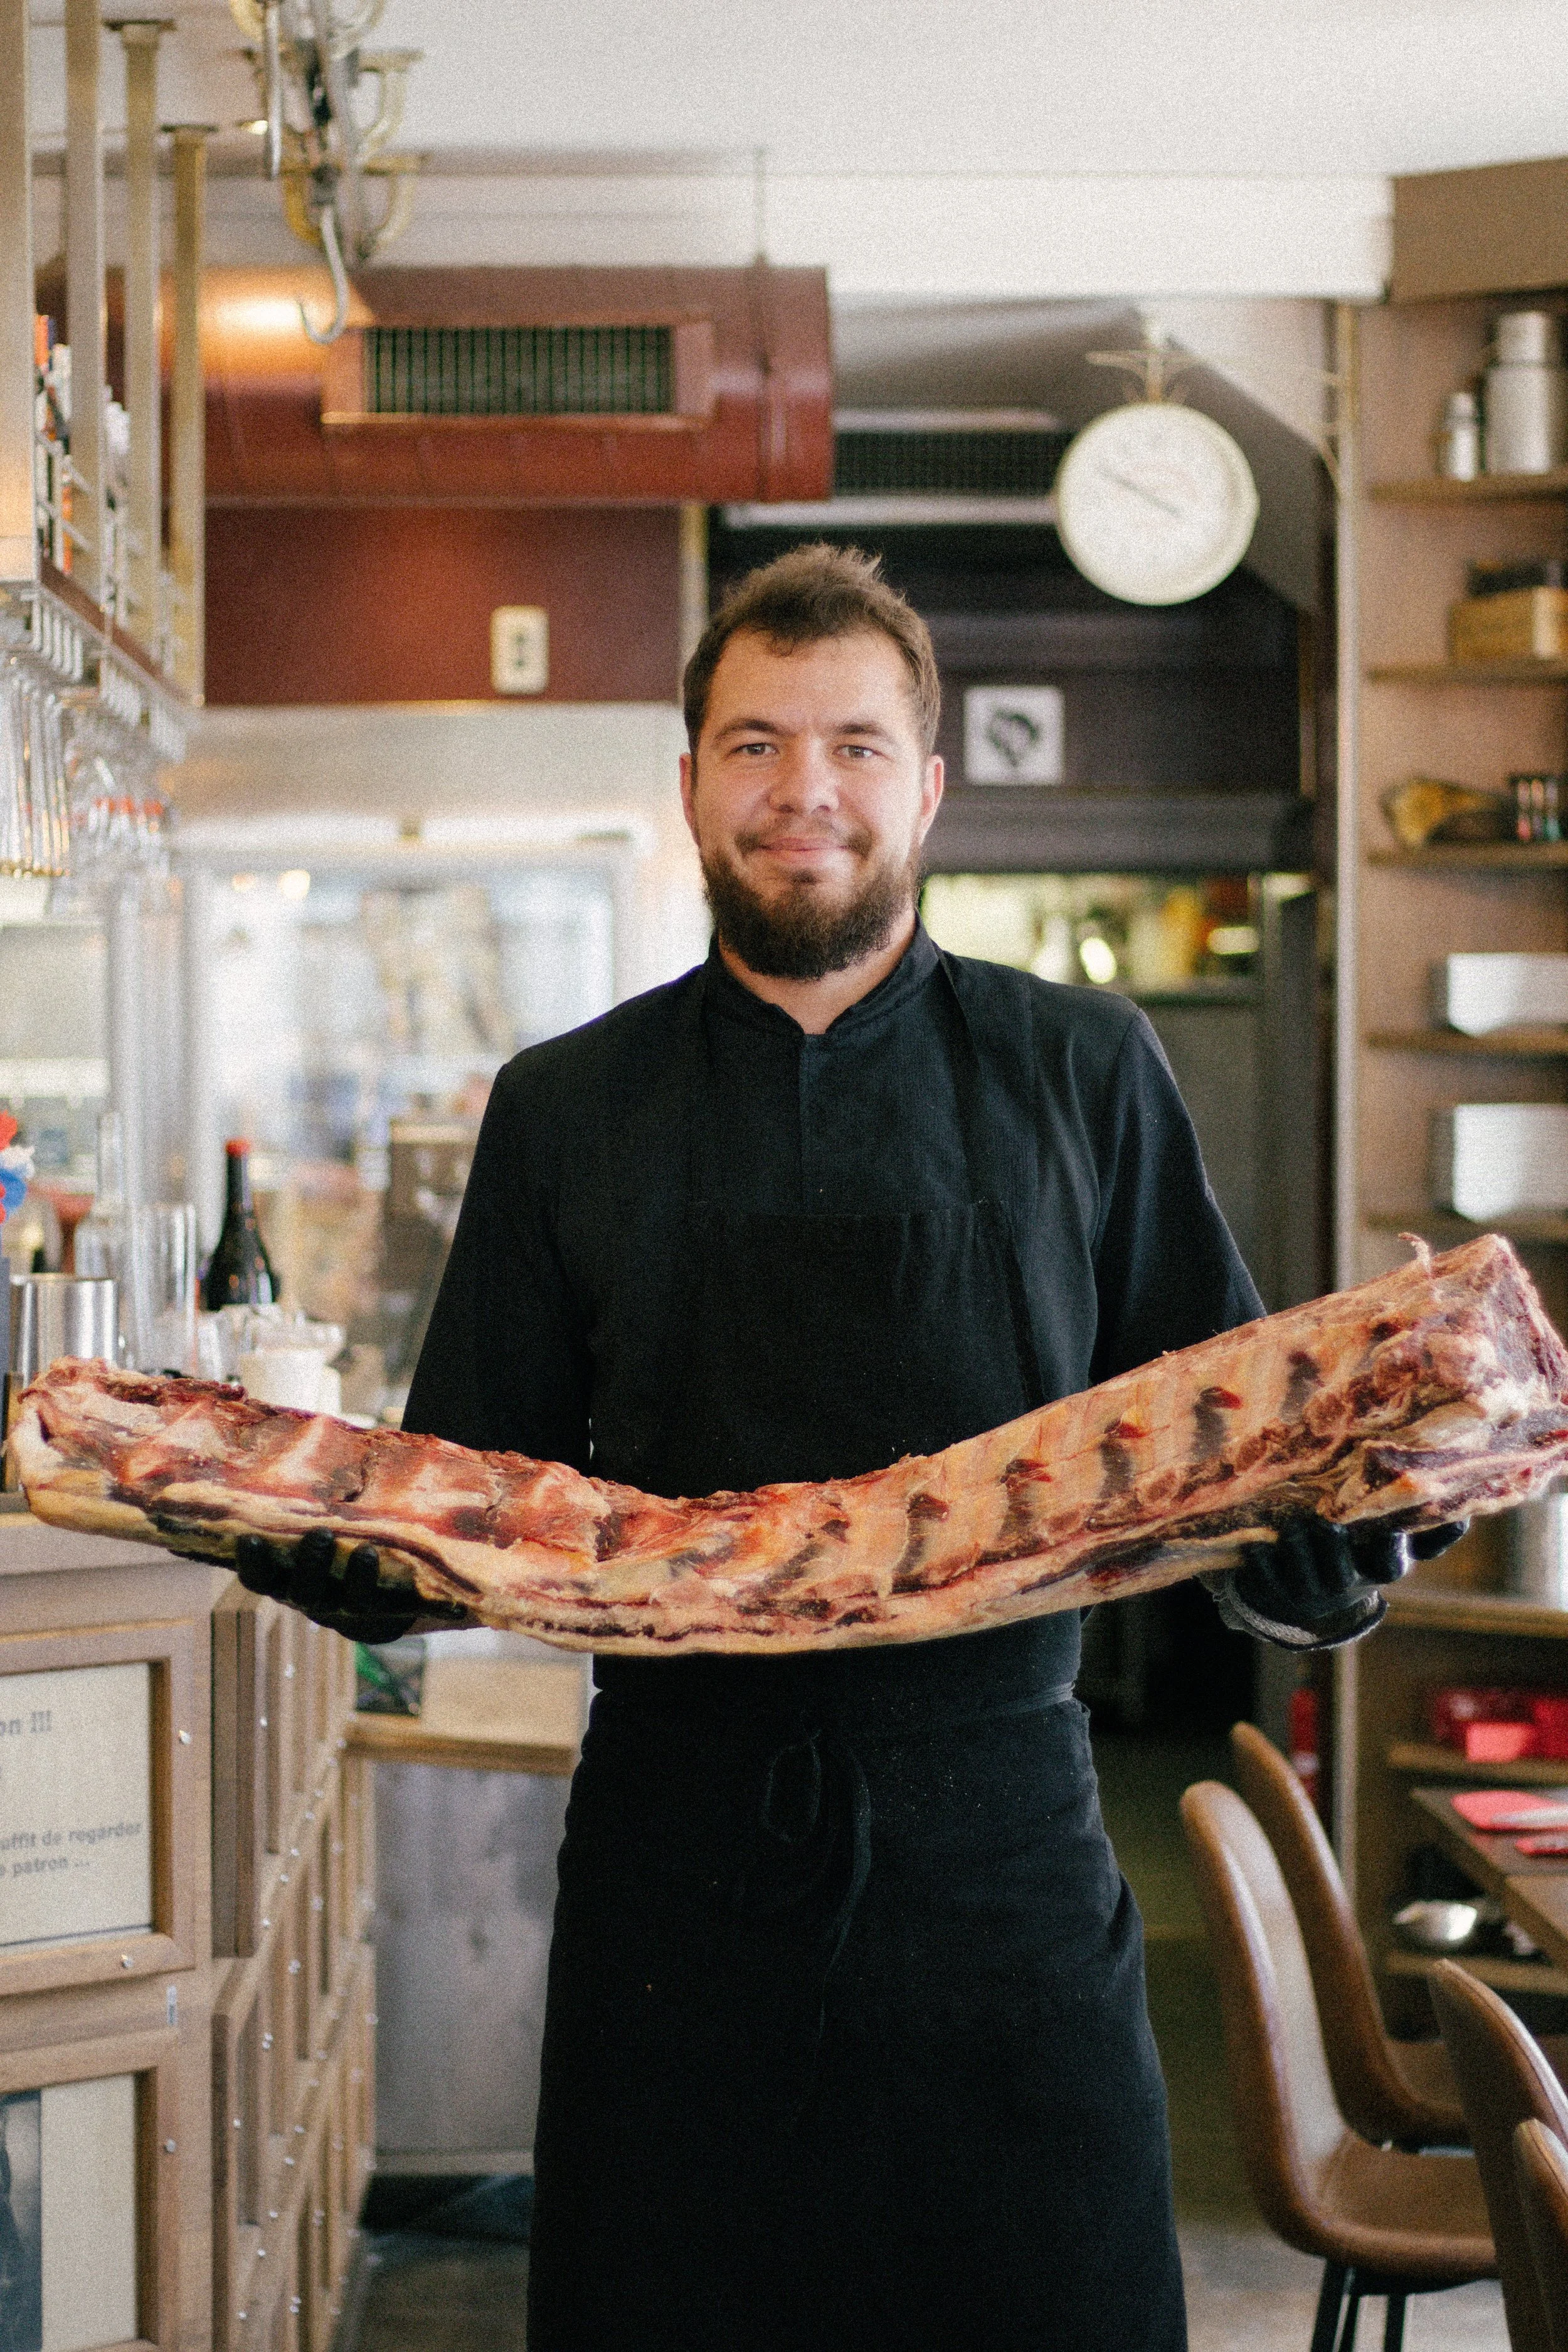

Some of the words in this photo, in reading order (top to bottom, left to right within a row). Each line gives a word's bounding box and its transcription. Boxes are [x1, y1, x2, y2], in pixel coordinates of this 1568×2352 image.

[41, 1828, 61, 1846] de
[68, 1822, 141, 1844] regarder
[13, 1855, 67, 1878] patron
